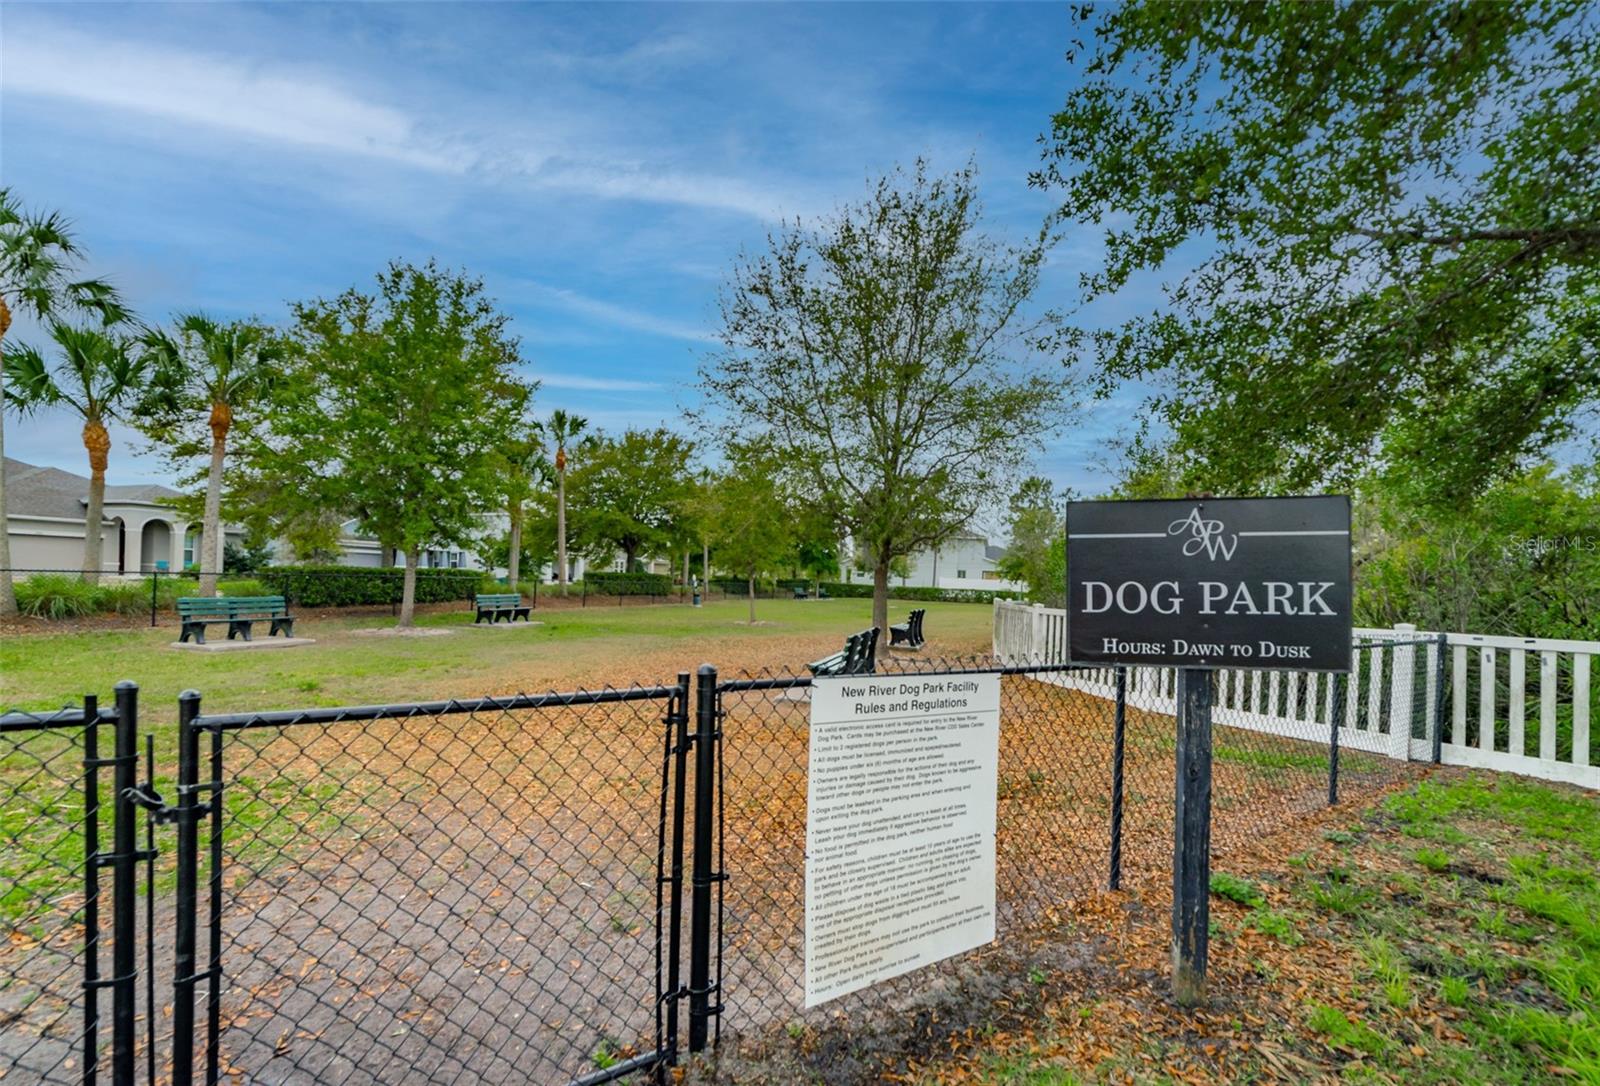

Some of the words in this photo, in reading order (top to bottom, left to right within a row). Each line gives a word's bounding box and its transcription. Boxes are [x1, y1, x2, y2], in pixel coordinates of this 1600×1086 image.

[1081, 581, 1184, 614] DOG
[1198, 581, 1337, 616] PARK
[841, 686, 865, 698] New
[869, 684, 896, 697] River
[900, 683, 920, 696] Dog
[923, 682, 944, 693] Park
[947, 681, 979, 693] Facility
[855, 702, 886, 715] Rules
[889, 700, 908, 712] and
[911, 698, 968, 712] Regulations
